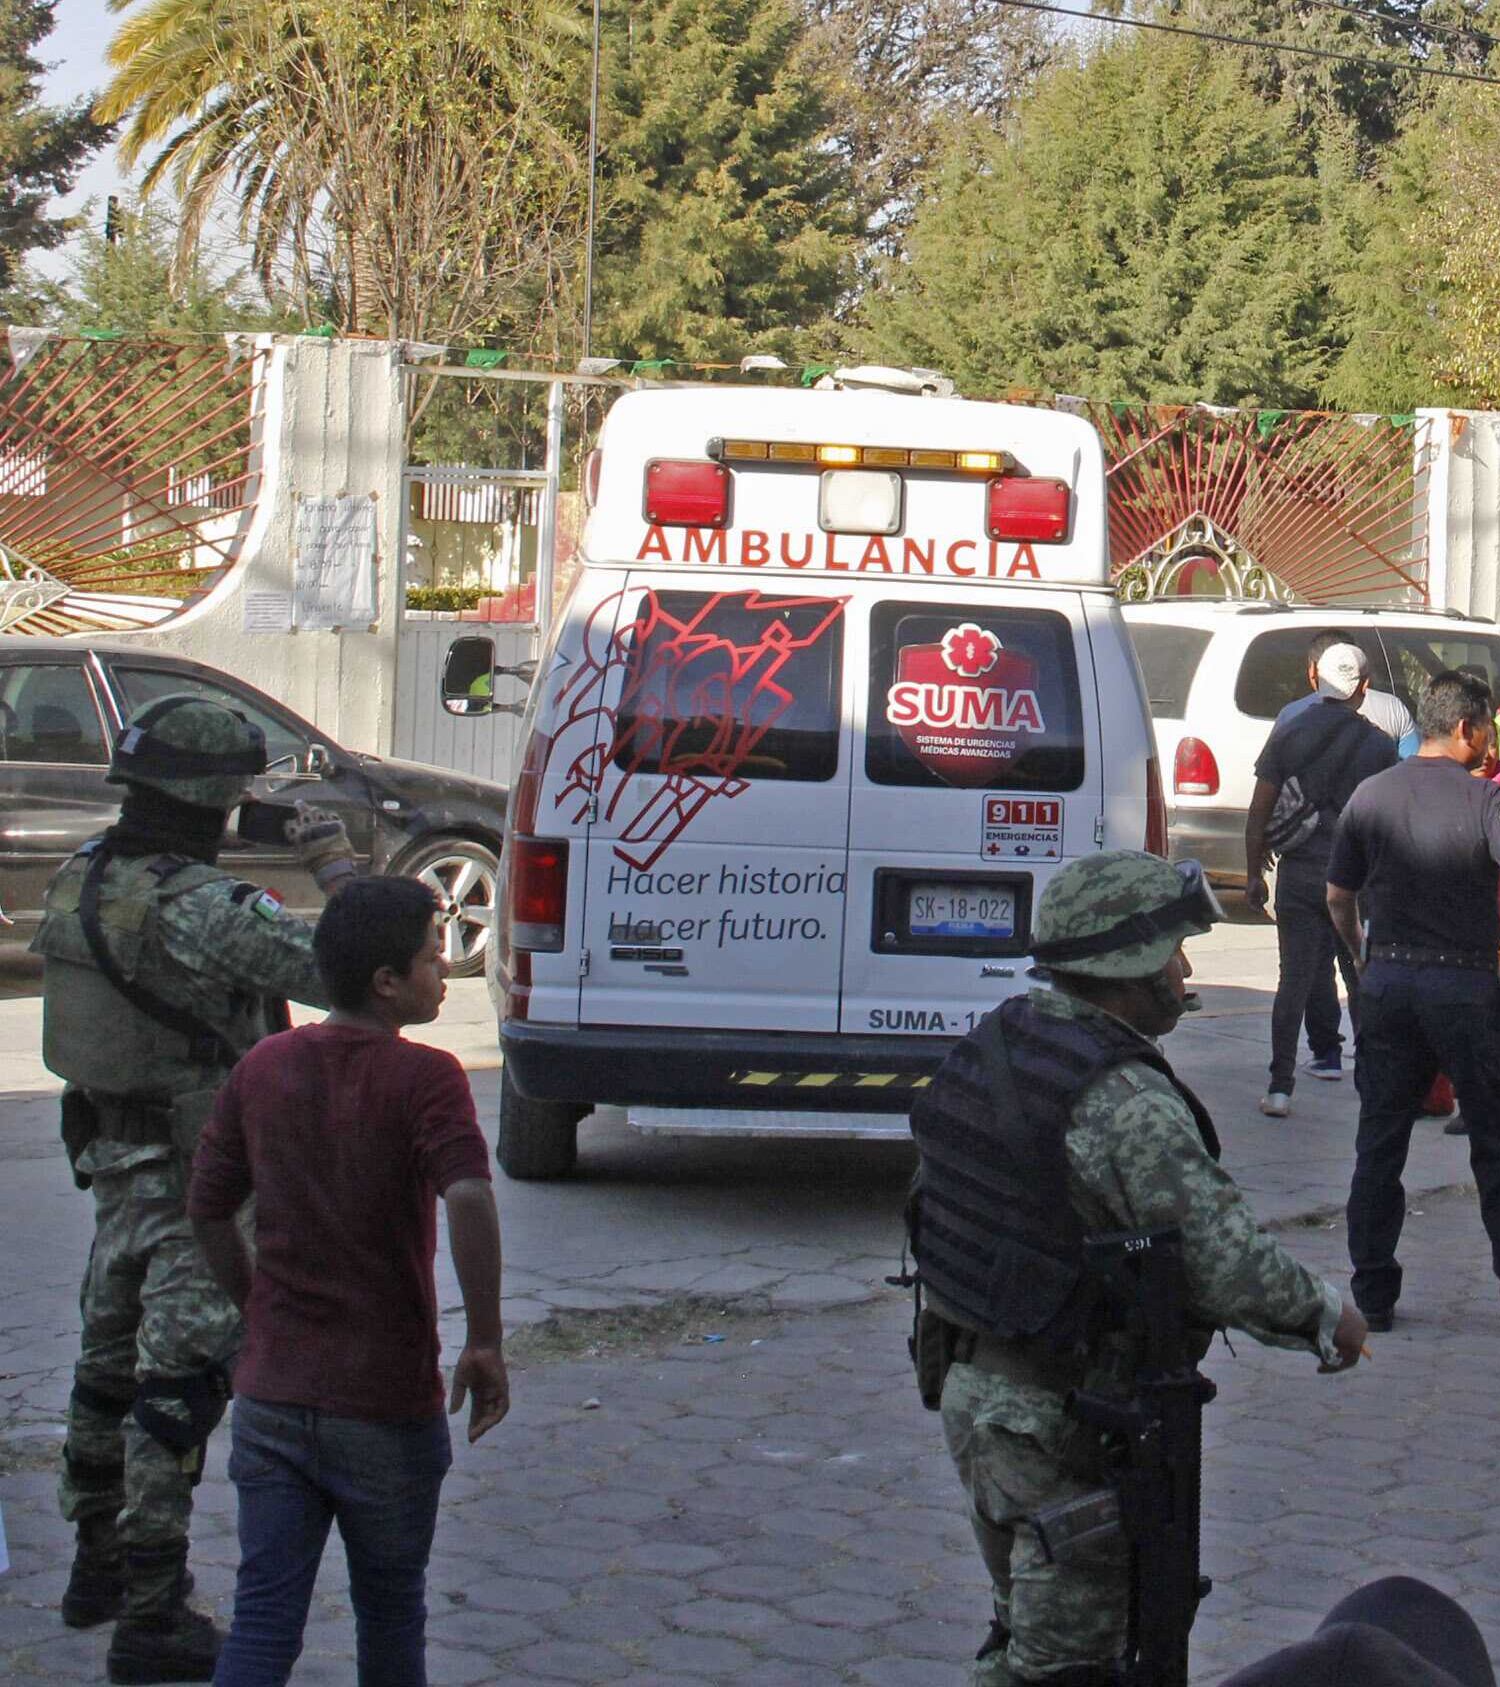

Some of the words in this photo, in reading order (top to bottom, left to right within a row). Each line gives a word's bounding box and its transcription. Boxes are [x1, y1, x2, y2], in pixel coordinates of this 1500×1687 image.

[636, 524, 1041, 578] AMBULANCIA
[889, 683, 1044, 732] SUMA
[916, 735, 952, 745] SISTEMA
[954, 737, 966, 746] DE
[967, 739, 1016, 749] URGENCIAS
[920, 745, 959, 756] MÉDICAS
[960, 748, 1011, 758] AVANZADAS
[990, 803, 1054, 822] 911
[986, 831, 1059, 843] EMERGENCIAS
[607, 865, 710, 895] Hacer
[718, 863, 847, 895] historia
[915, 896, 1010, 920] SK-18-022
[607, 911, 710, 941] Hacer
[717, 908, 826, 948] futuro.
[869, 1009, 946, 1031] SUMA
